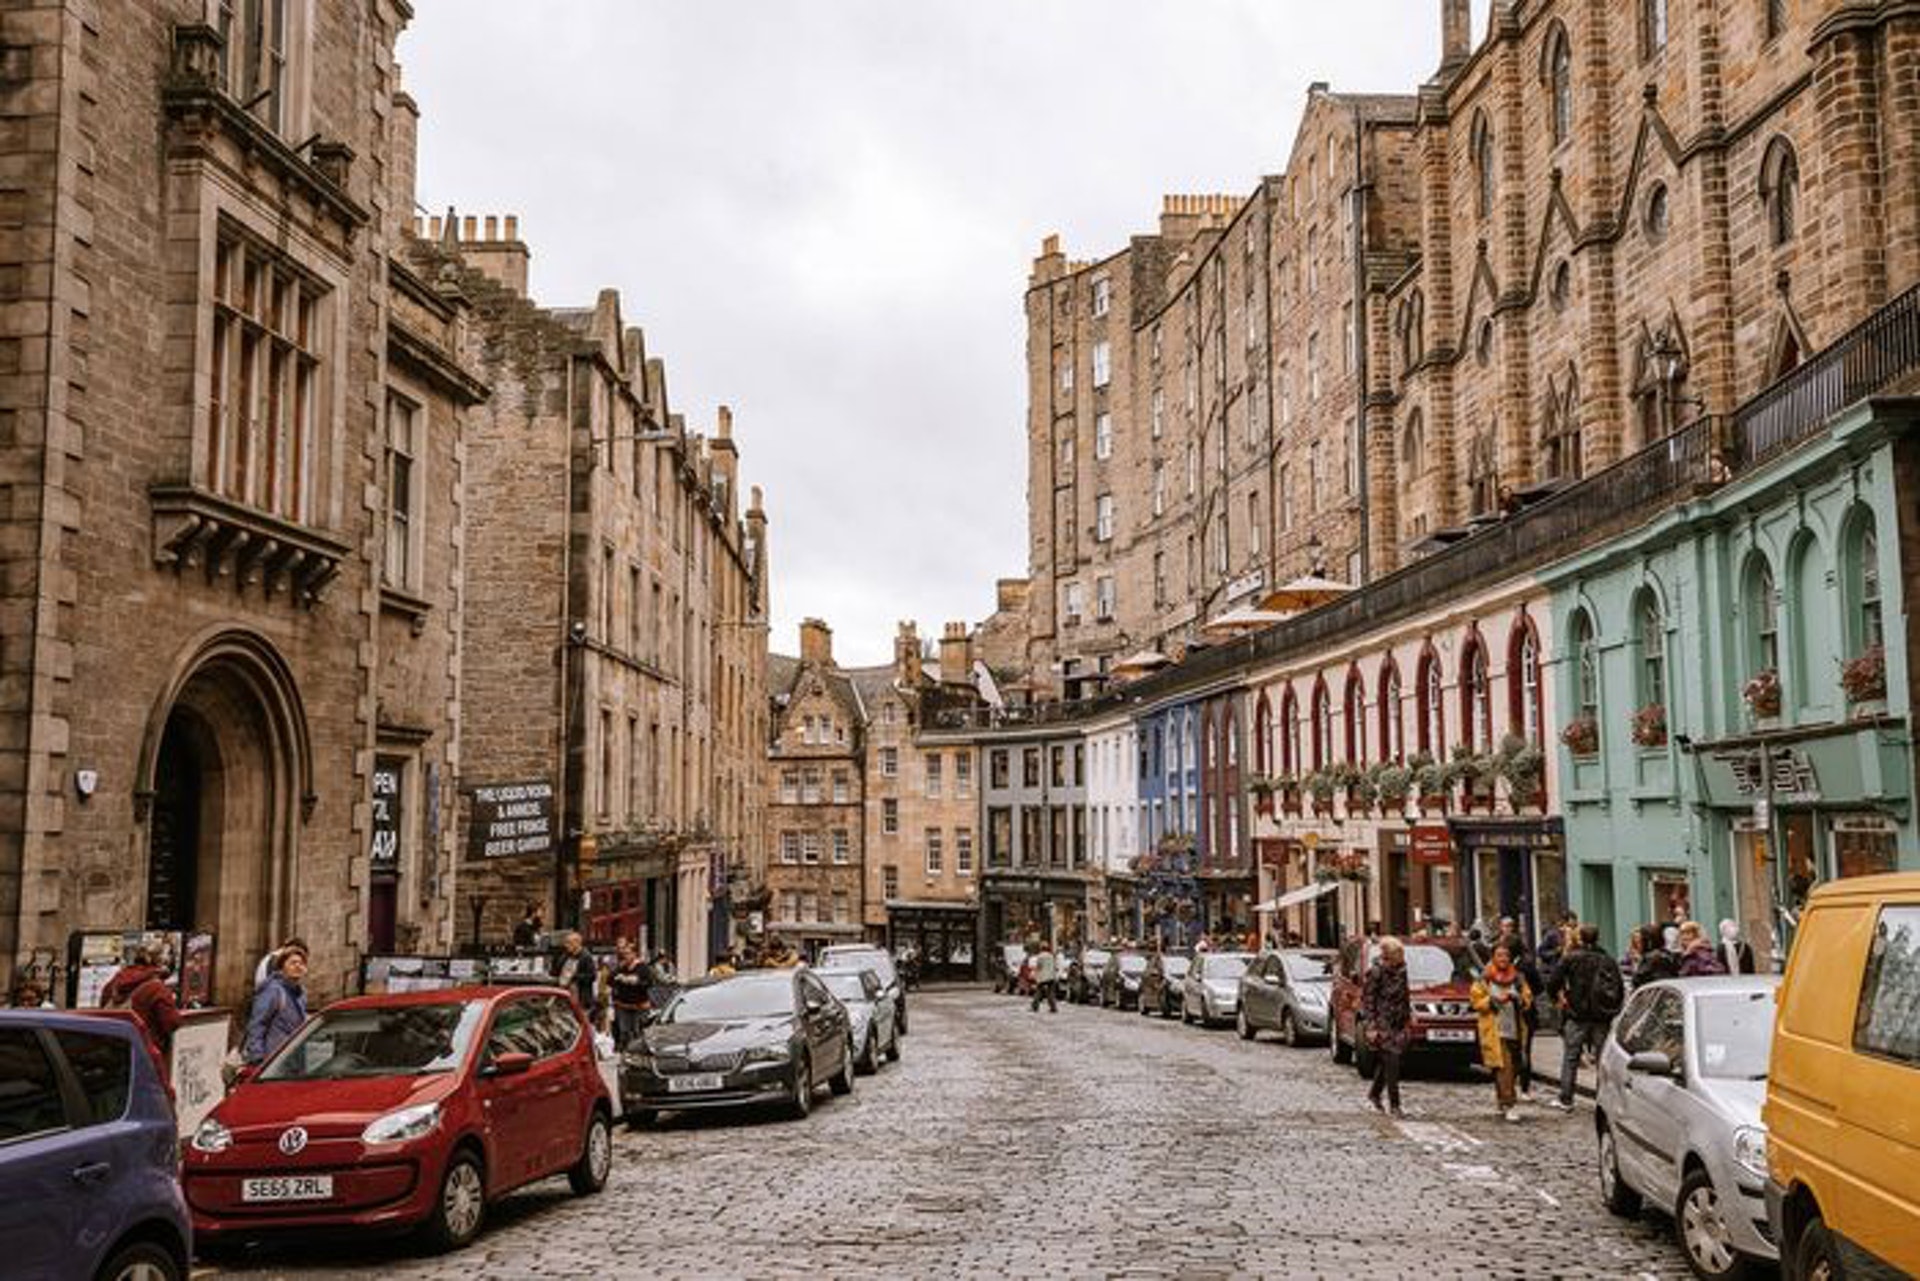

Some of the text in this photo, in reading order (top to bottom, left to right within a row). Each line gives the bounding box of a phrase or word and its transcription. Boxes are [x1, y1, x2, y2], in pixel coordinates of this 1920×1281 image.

[373, 772, 397, 794] PEN
[476, 788, 497, 803] THE
[490, 821, 517, 838] FREE
[484, 839, 517, 857] BEER
[249, 1179, 325, 1197] SE65 ZRL
